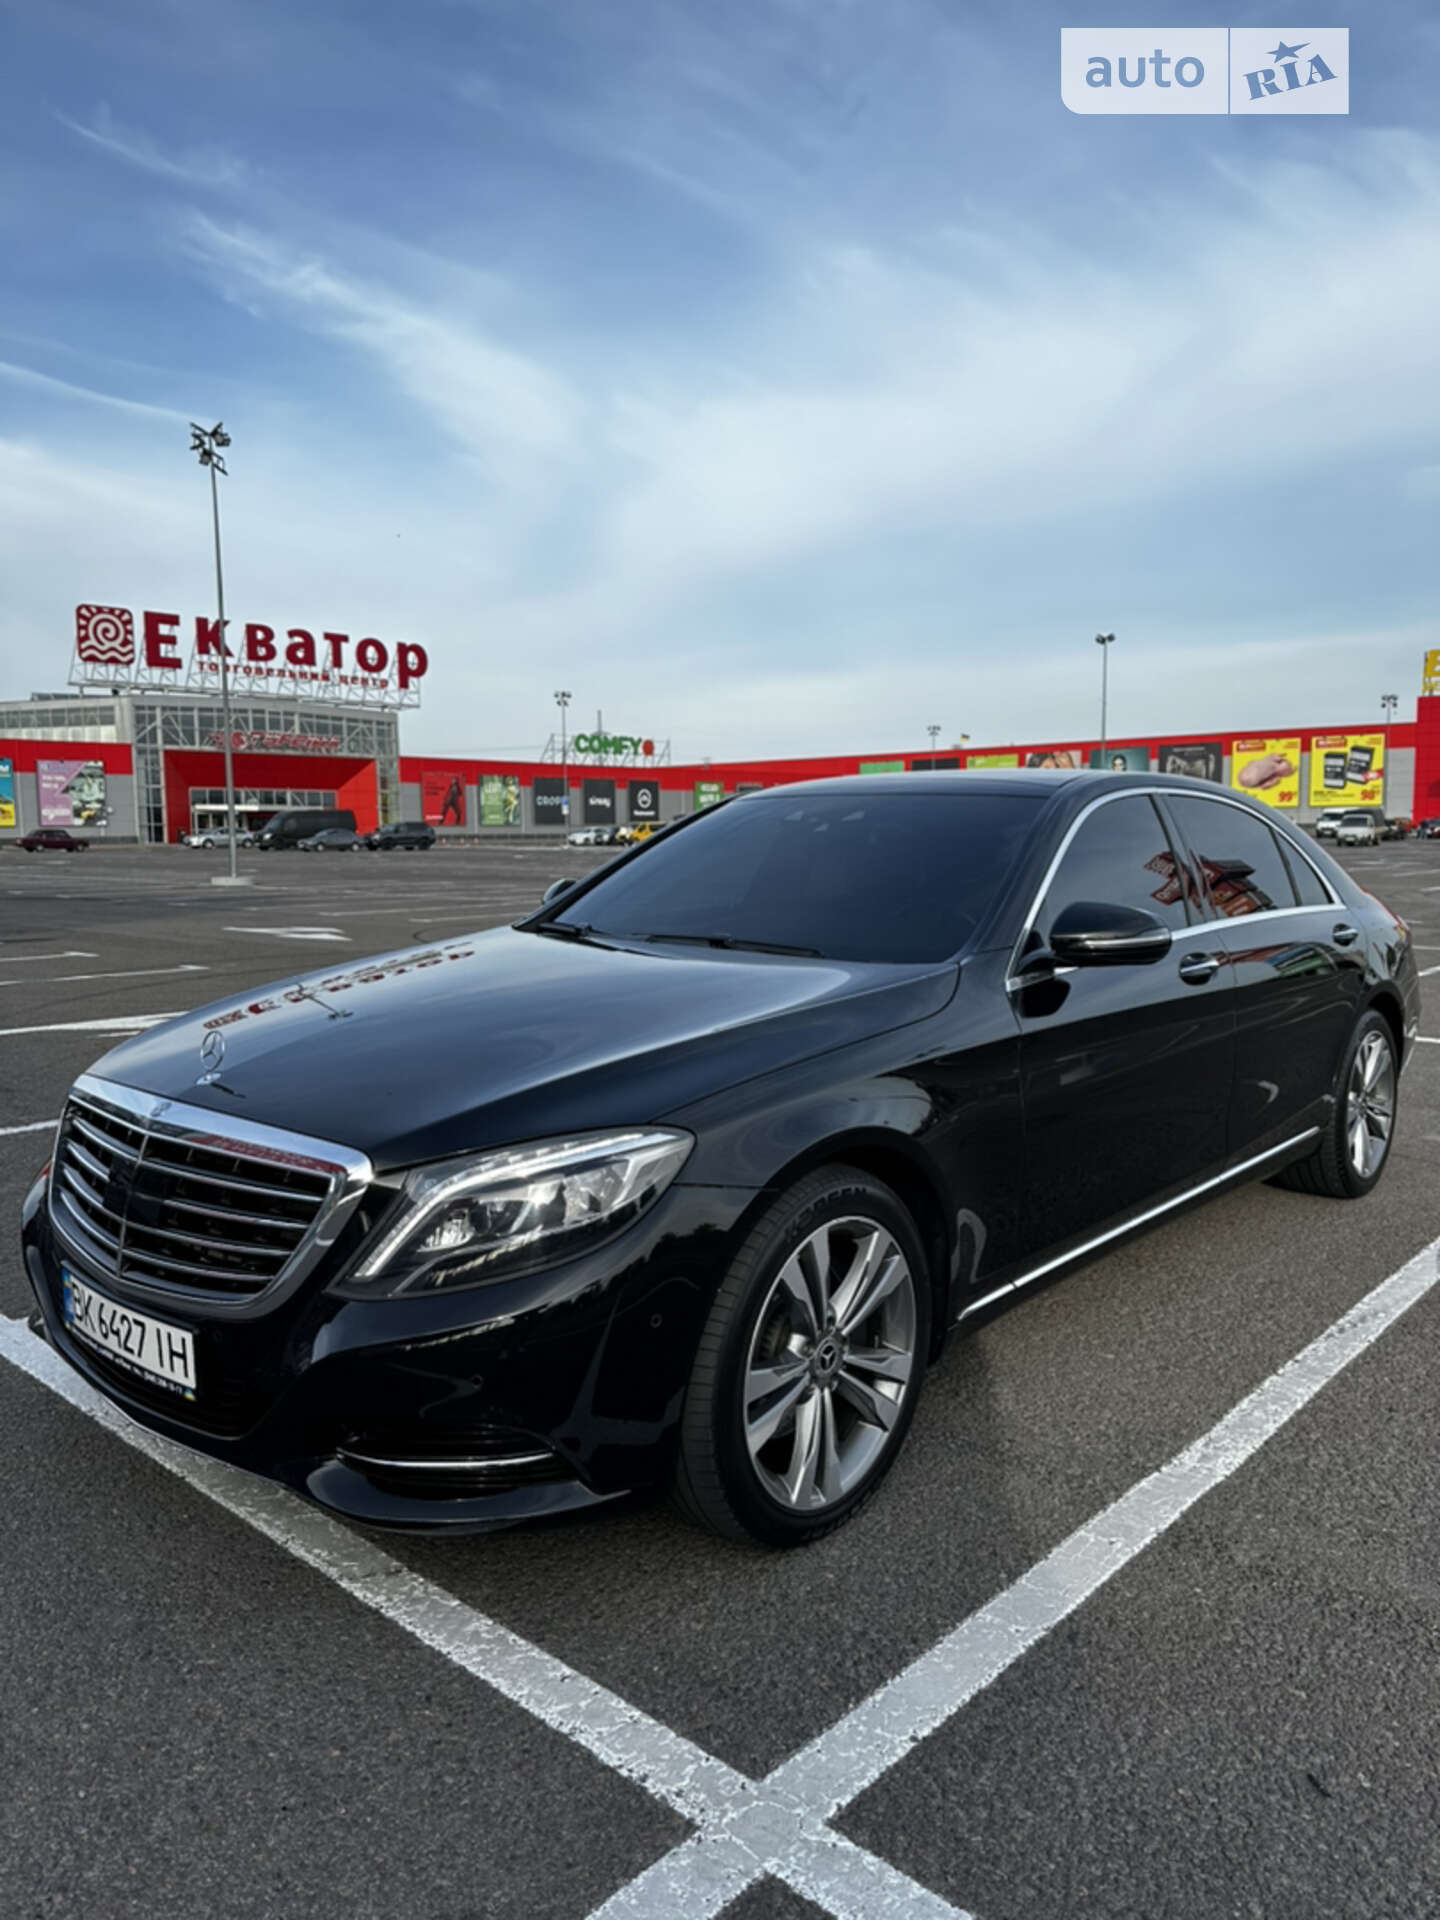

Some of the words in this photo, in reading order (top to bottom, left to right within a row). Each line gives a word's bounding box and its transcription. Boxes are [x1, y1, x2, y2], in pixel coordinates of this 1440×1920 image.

[575, 733, 643, 756] COMFY
[98, 1302, 146, 1358] 6427
[156, 1327, 189, 1379] IH
